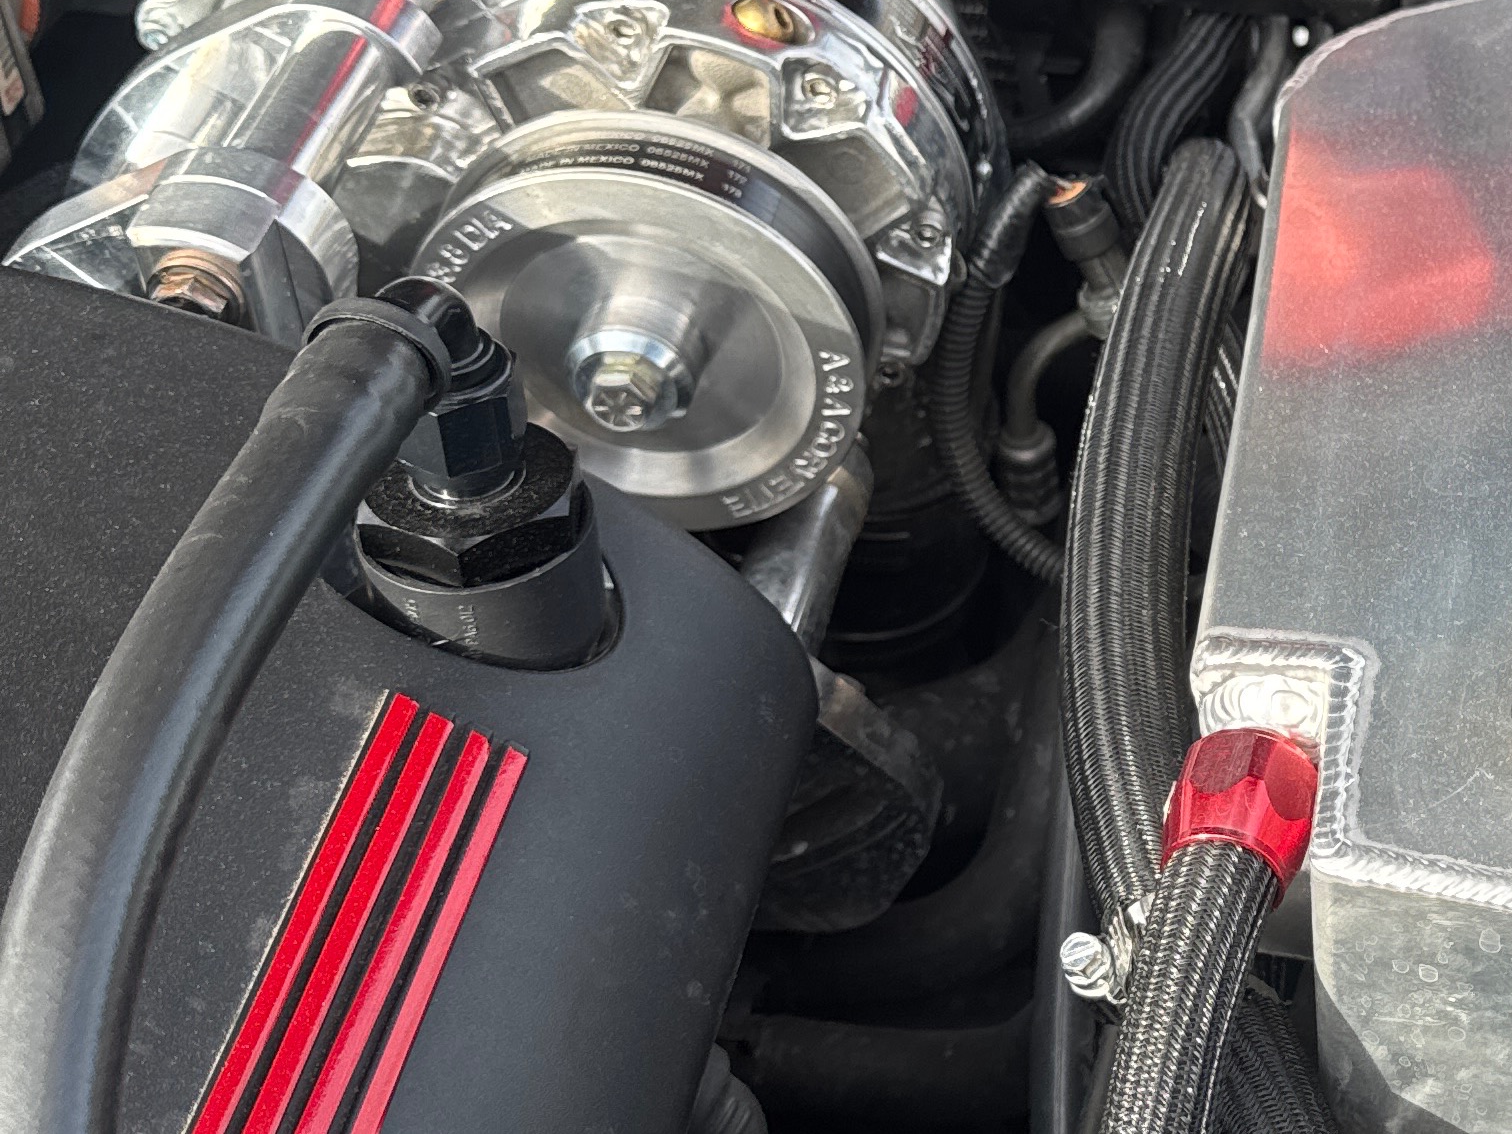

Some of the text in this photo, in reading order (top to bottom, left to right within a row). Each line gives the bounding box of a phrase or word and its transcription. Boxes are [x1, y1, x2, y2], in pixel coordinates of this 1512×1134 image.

[576, 154, 635, 165] MEXICO
[451, 210, 514, 252] DIA
[720, 420, 846, 519] CORVETTE
